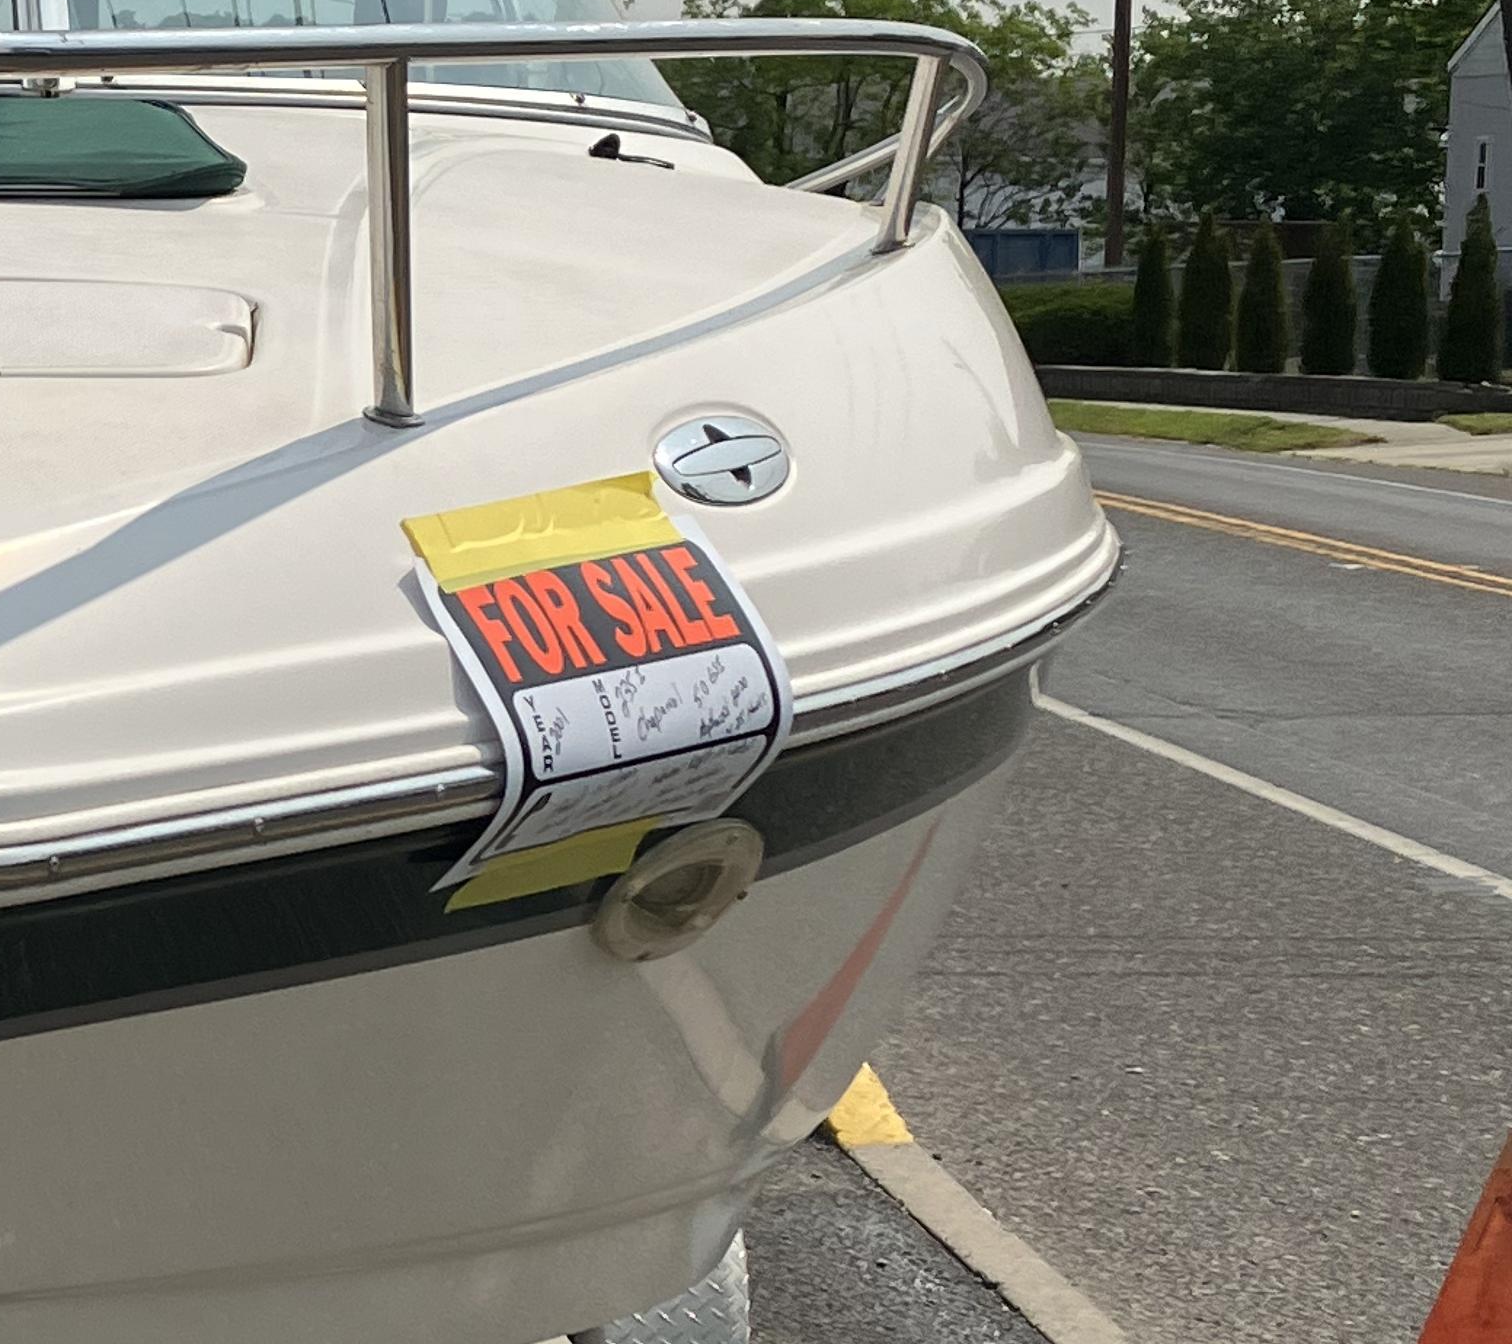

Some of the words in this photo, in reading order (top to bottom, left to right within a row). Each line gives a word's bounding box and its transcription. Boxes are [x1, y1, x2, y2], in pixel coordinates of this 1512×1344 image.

[457, 570, 607, 683] FOR
[582, 547, 740, 657] SALE
[523, 695, 554, 773] YEAR
[592, 678, 622, 759] MODEL
